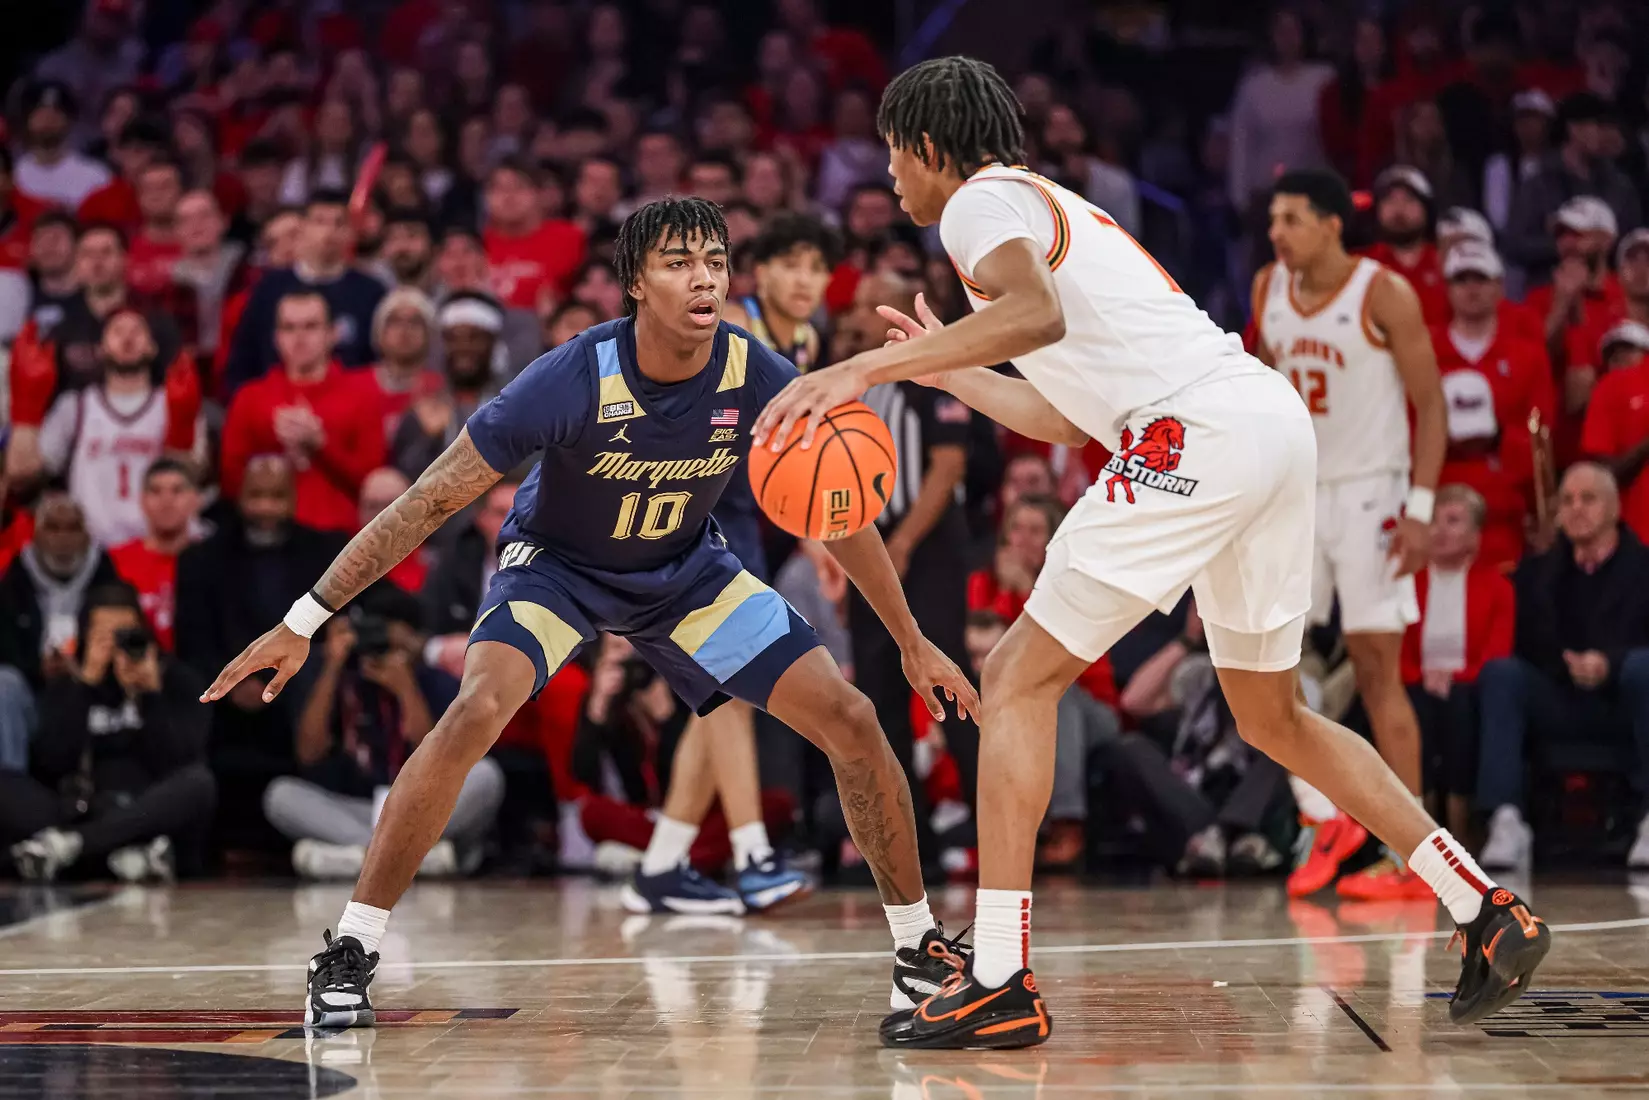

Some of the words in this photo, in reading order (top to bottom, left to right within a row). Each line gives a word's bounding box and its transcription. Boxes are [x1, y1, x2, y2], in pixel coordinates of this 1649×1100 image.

[1290, 368, 1329, 415] 12
[586, 448, 739, 489] Marquette
[610, 491, 693, 540] 10
